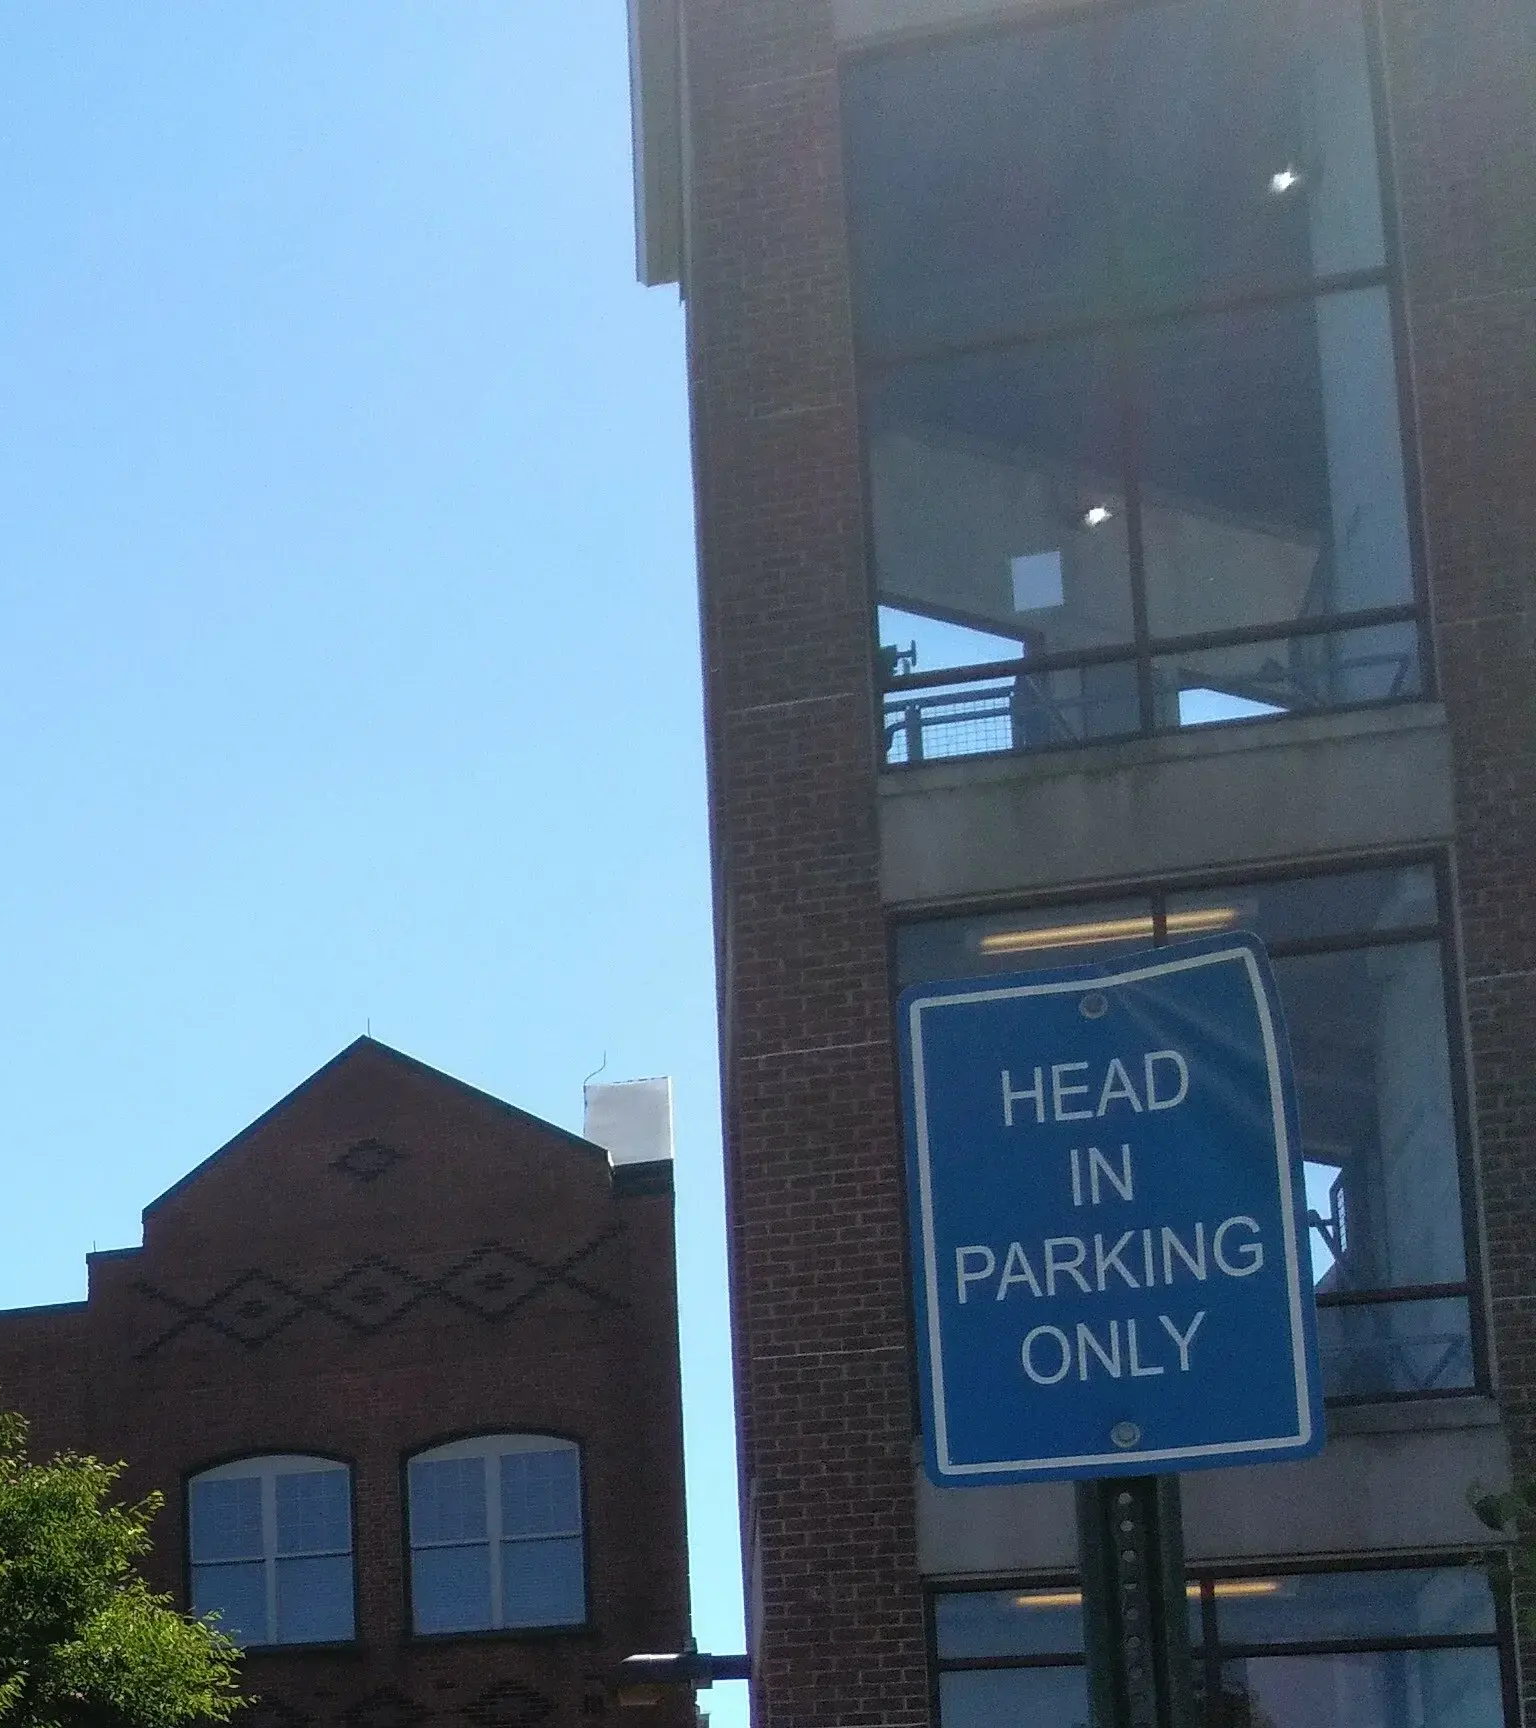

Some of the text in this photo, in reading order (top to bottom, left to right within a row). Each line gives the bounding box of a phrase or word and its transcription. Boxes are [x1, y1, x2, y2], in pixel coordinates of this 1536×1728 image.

[1001, 1050, 1190, 1127] HEAD
[1069, 1143, 1134, 1207] IN
[955, 1216, 1265, 1304] PARKING
[1021, 1311, 1207, 1386] ONLY
